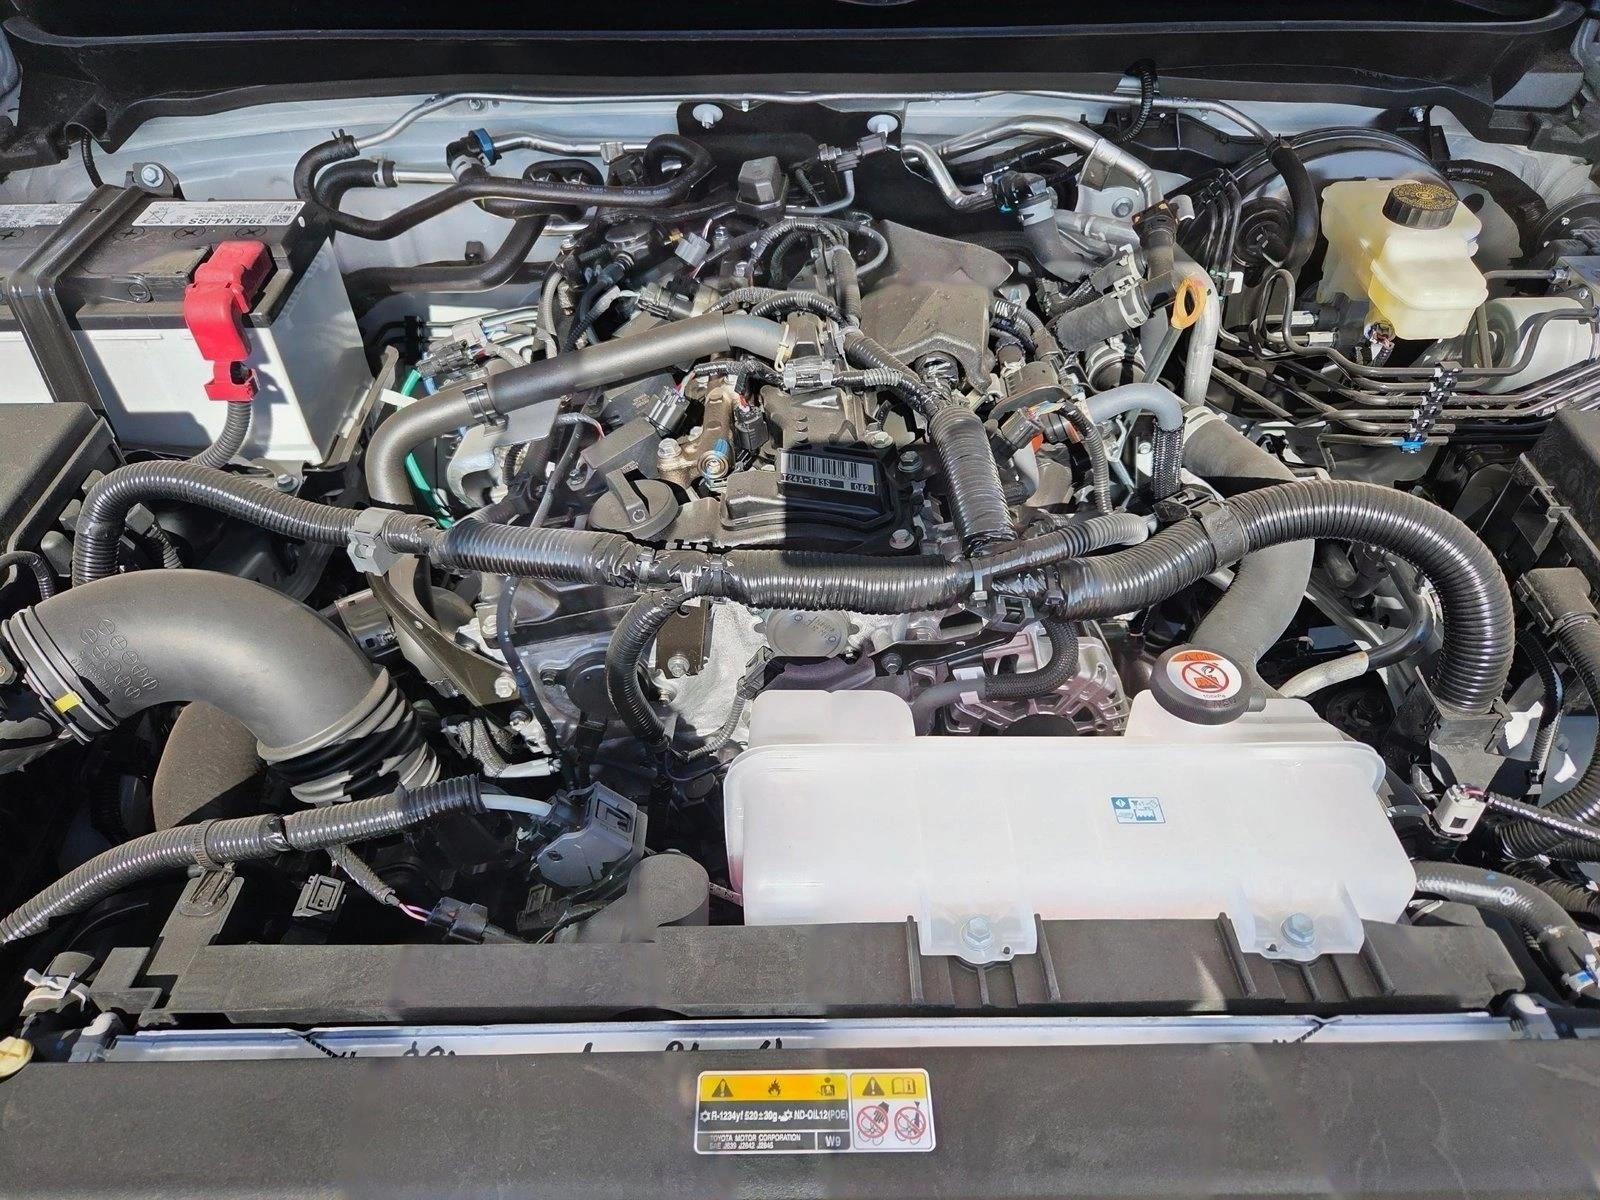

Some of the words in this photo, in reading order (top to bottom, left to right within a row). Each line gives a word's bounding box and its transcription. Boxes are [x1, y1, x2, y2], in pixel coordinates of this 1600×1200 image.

[711, 1110, 744, 1122] R-1234yf
[709, 1134, 733, 1142] TOYOTA
[758, 1133, 801, 1141] CORPORATION
[825, 1135, 841, 1147] W9
